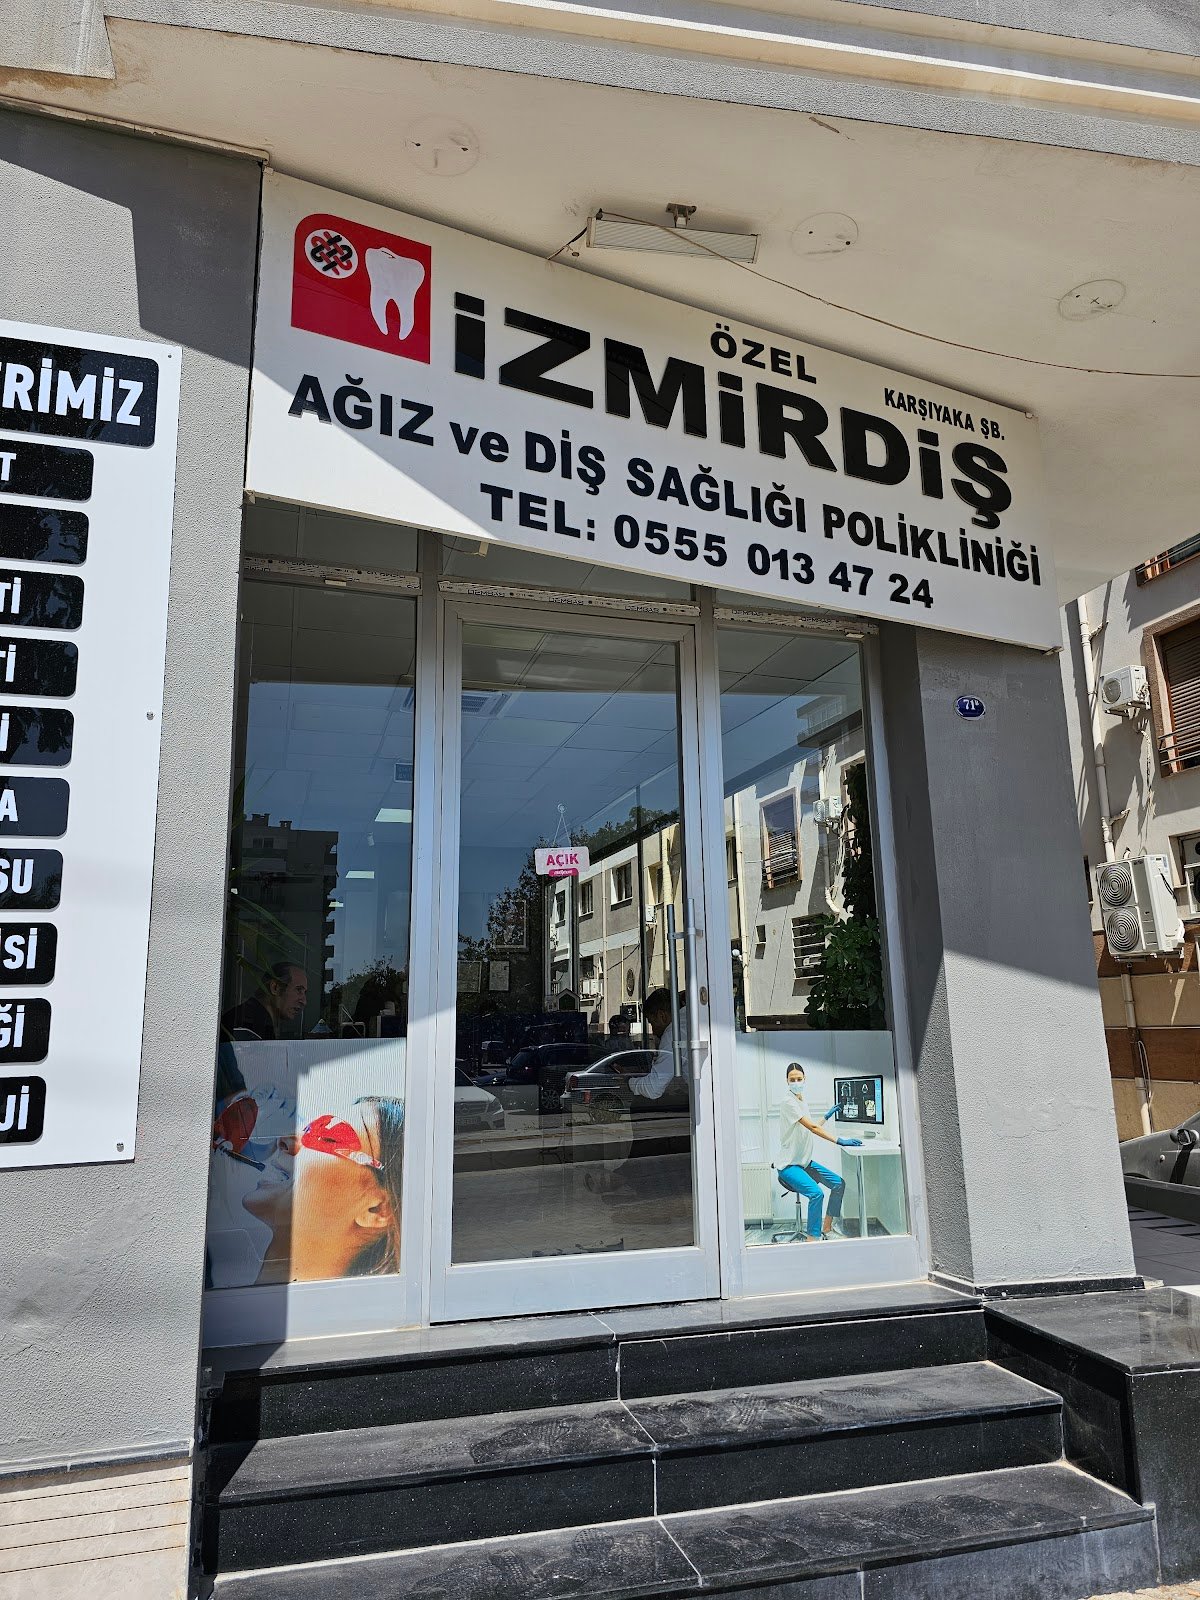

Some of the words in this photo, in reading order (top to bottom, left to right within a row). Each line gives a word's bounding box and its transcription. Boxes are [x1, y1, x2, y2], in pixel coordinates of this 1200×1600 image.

[710, 323, 817, 384] ÖZEL
[0, 357, 144, 426] RİMİZ
[884, 387, 975, 433] KARŞIYAKA
[980, 417, 1006, 441] ŞB.
[288, 373, 434, 446] AĞIZ
[449, 421, 509, 463] ve
[525, 429, 606, 496] DİŞ
[626, 456, 807, 533] SAĞLIĞI
[822, 502, 1042, 587] POLİKLİNİĞİ
[480, 482, 595, 542] TEL:
[613, 513, 729, 568] 0555
[746, 542, 816, 585] 013
[828, 561, 874, 597] 47
[888, 572, 934, 610] 24
[546, 853, 580, 867] AÇIK
[0, 927, 38, 970] Sİ
